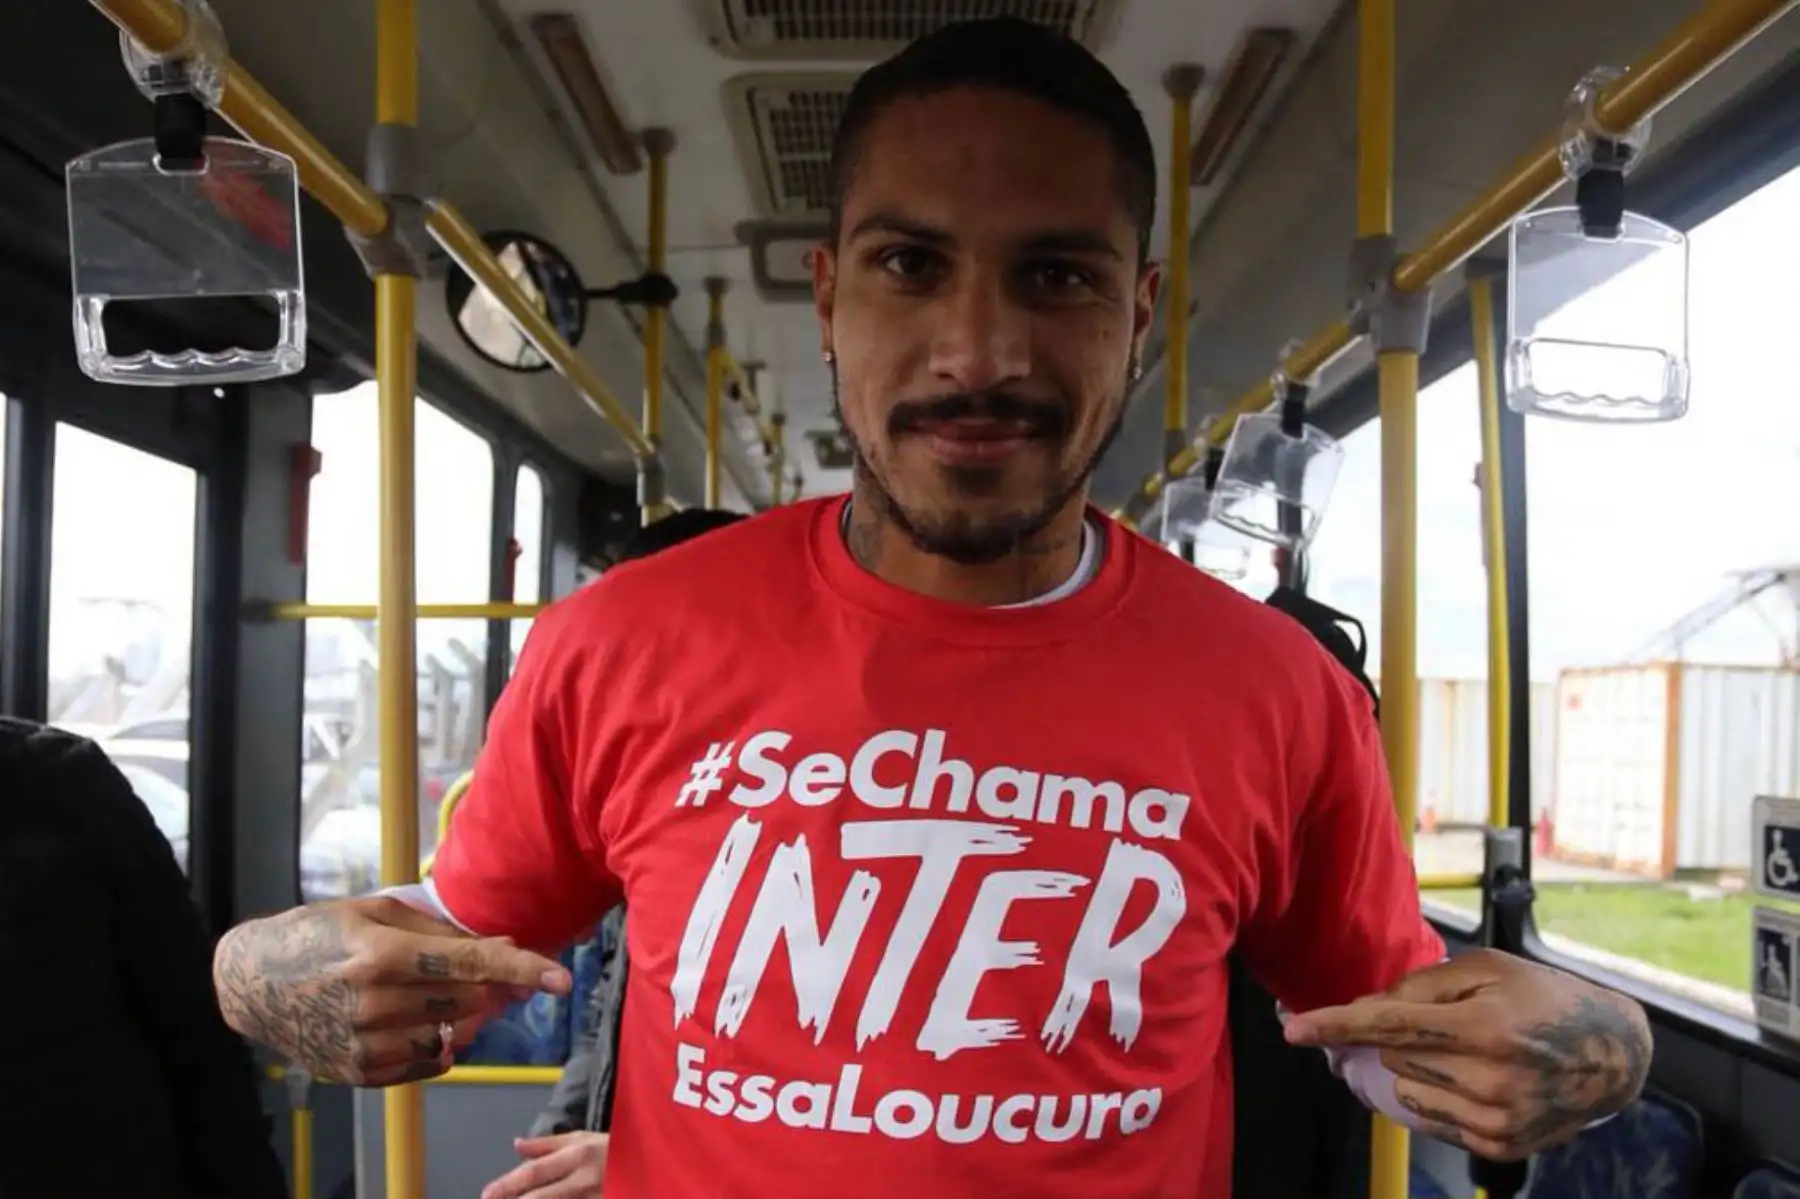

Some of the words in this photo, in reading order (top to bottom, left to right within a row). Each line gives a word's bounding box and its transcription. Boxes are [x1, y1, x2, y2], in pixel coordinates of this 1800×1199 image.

[675, 730, 1191, 841] #SeChama
[670, 812, 1187, 1061] INTER
[672, 1043, 1162, 1144] EssaLoucura
